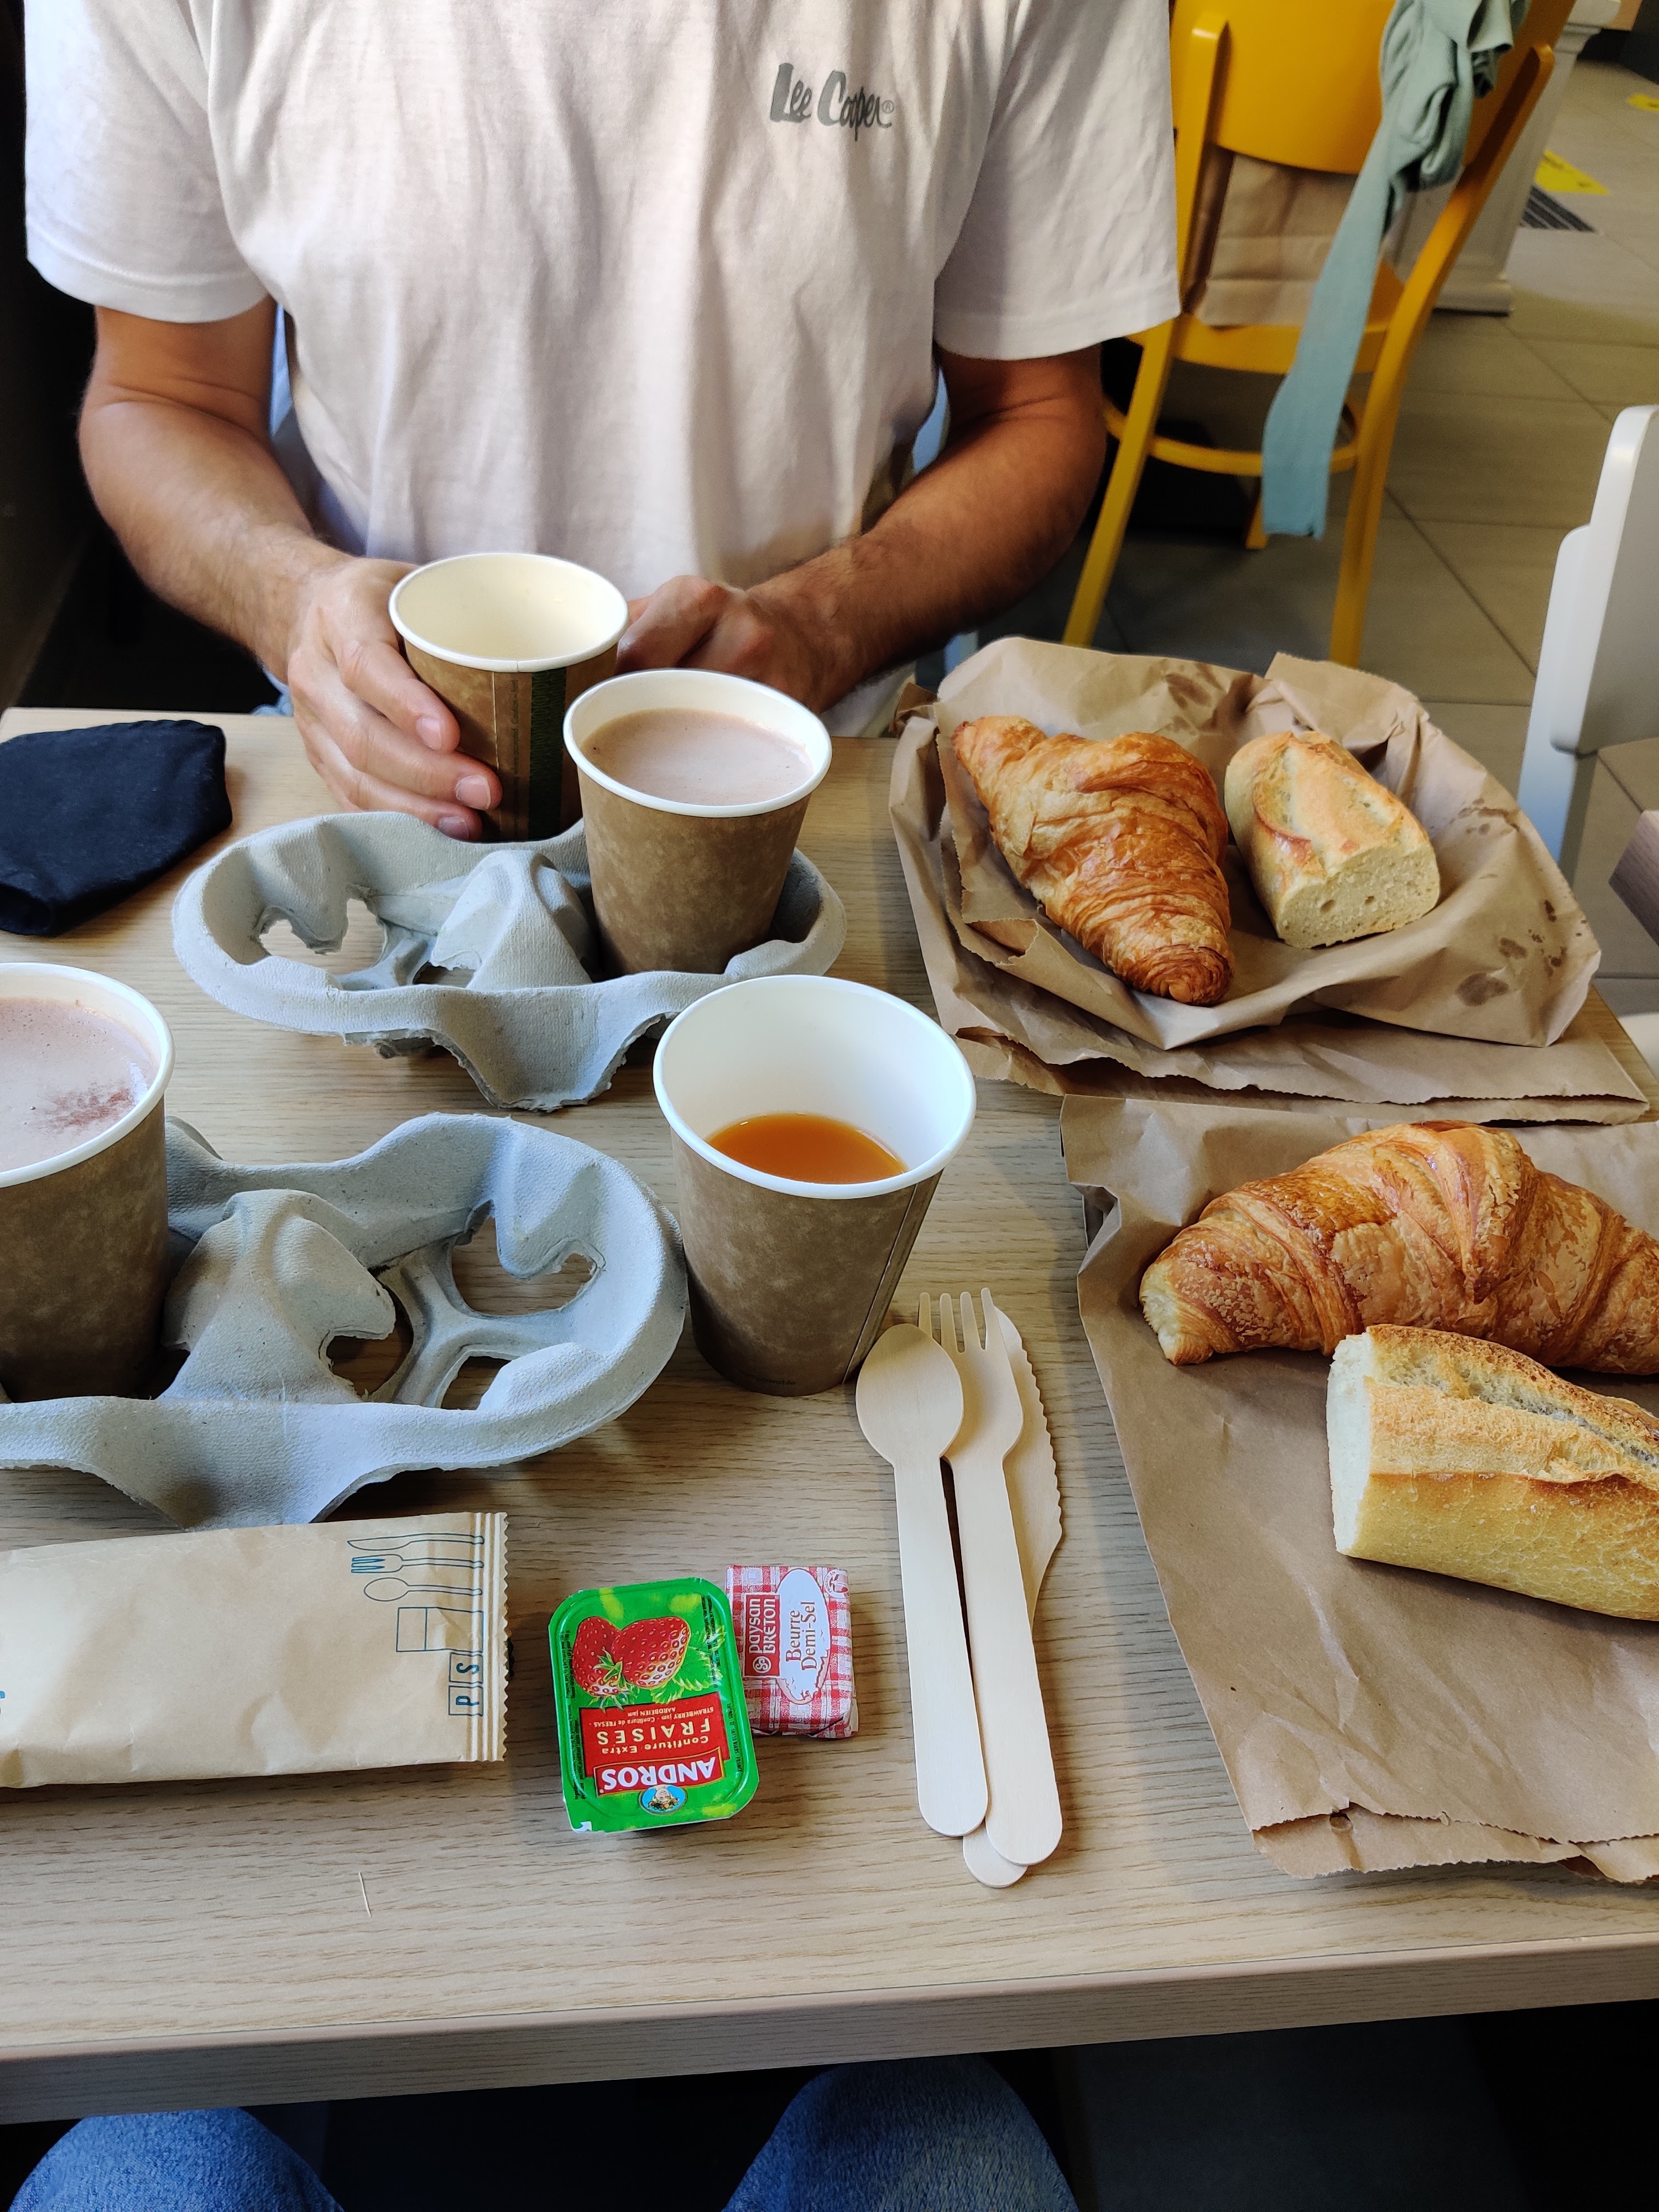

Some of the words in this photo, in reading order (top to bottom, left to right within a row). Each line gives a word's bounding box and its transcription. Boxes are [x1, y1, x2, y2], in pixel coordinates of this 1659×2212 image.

[770, 62, 812, 123] Lee
[785, 1610, 801, 1662] Beurre
[801, 1601, 817, 1670] Demi-Sel
[456, 1662, 479, 1674] S
[456, 1695, 479, 1705] P
[627, 1708, 639, 1717] jam
[674, 1707, 714, 1720] STRAWBERRY
[597, 1718, 711, 1745] FRAISES
[602, 1745, 638, 1755] Extra
[644, 1735, 709, 1750] Confiture
[601, 1756, 716, 1790] ANDROS
